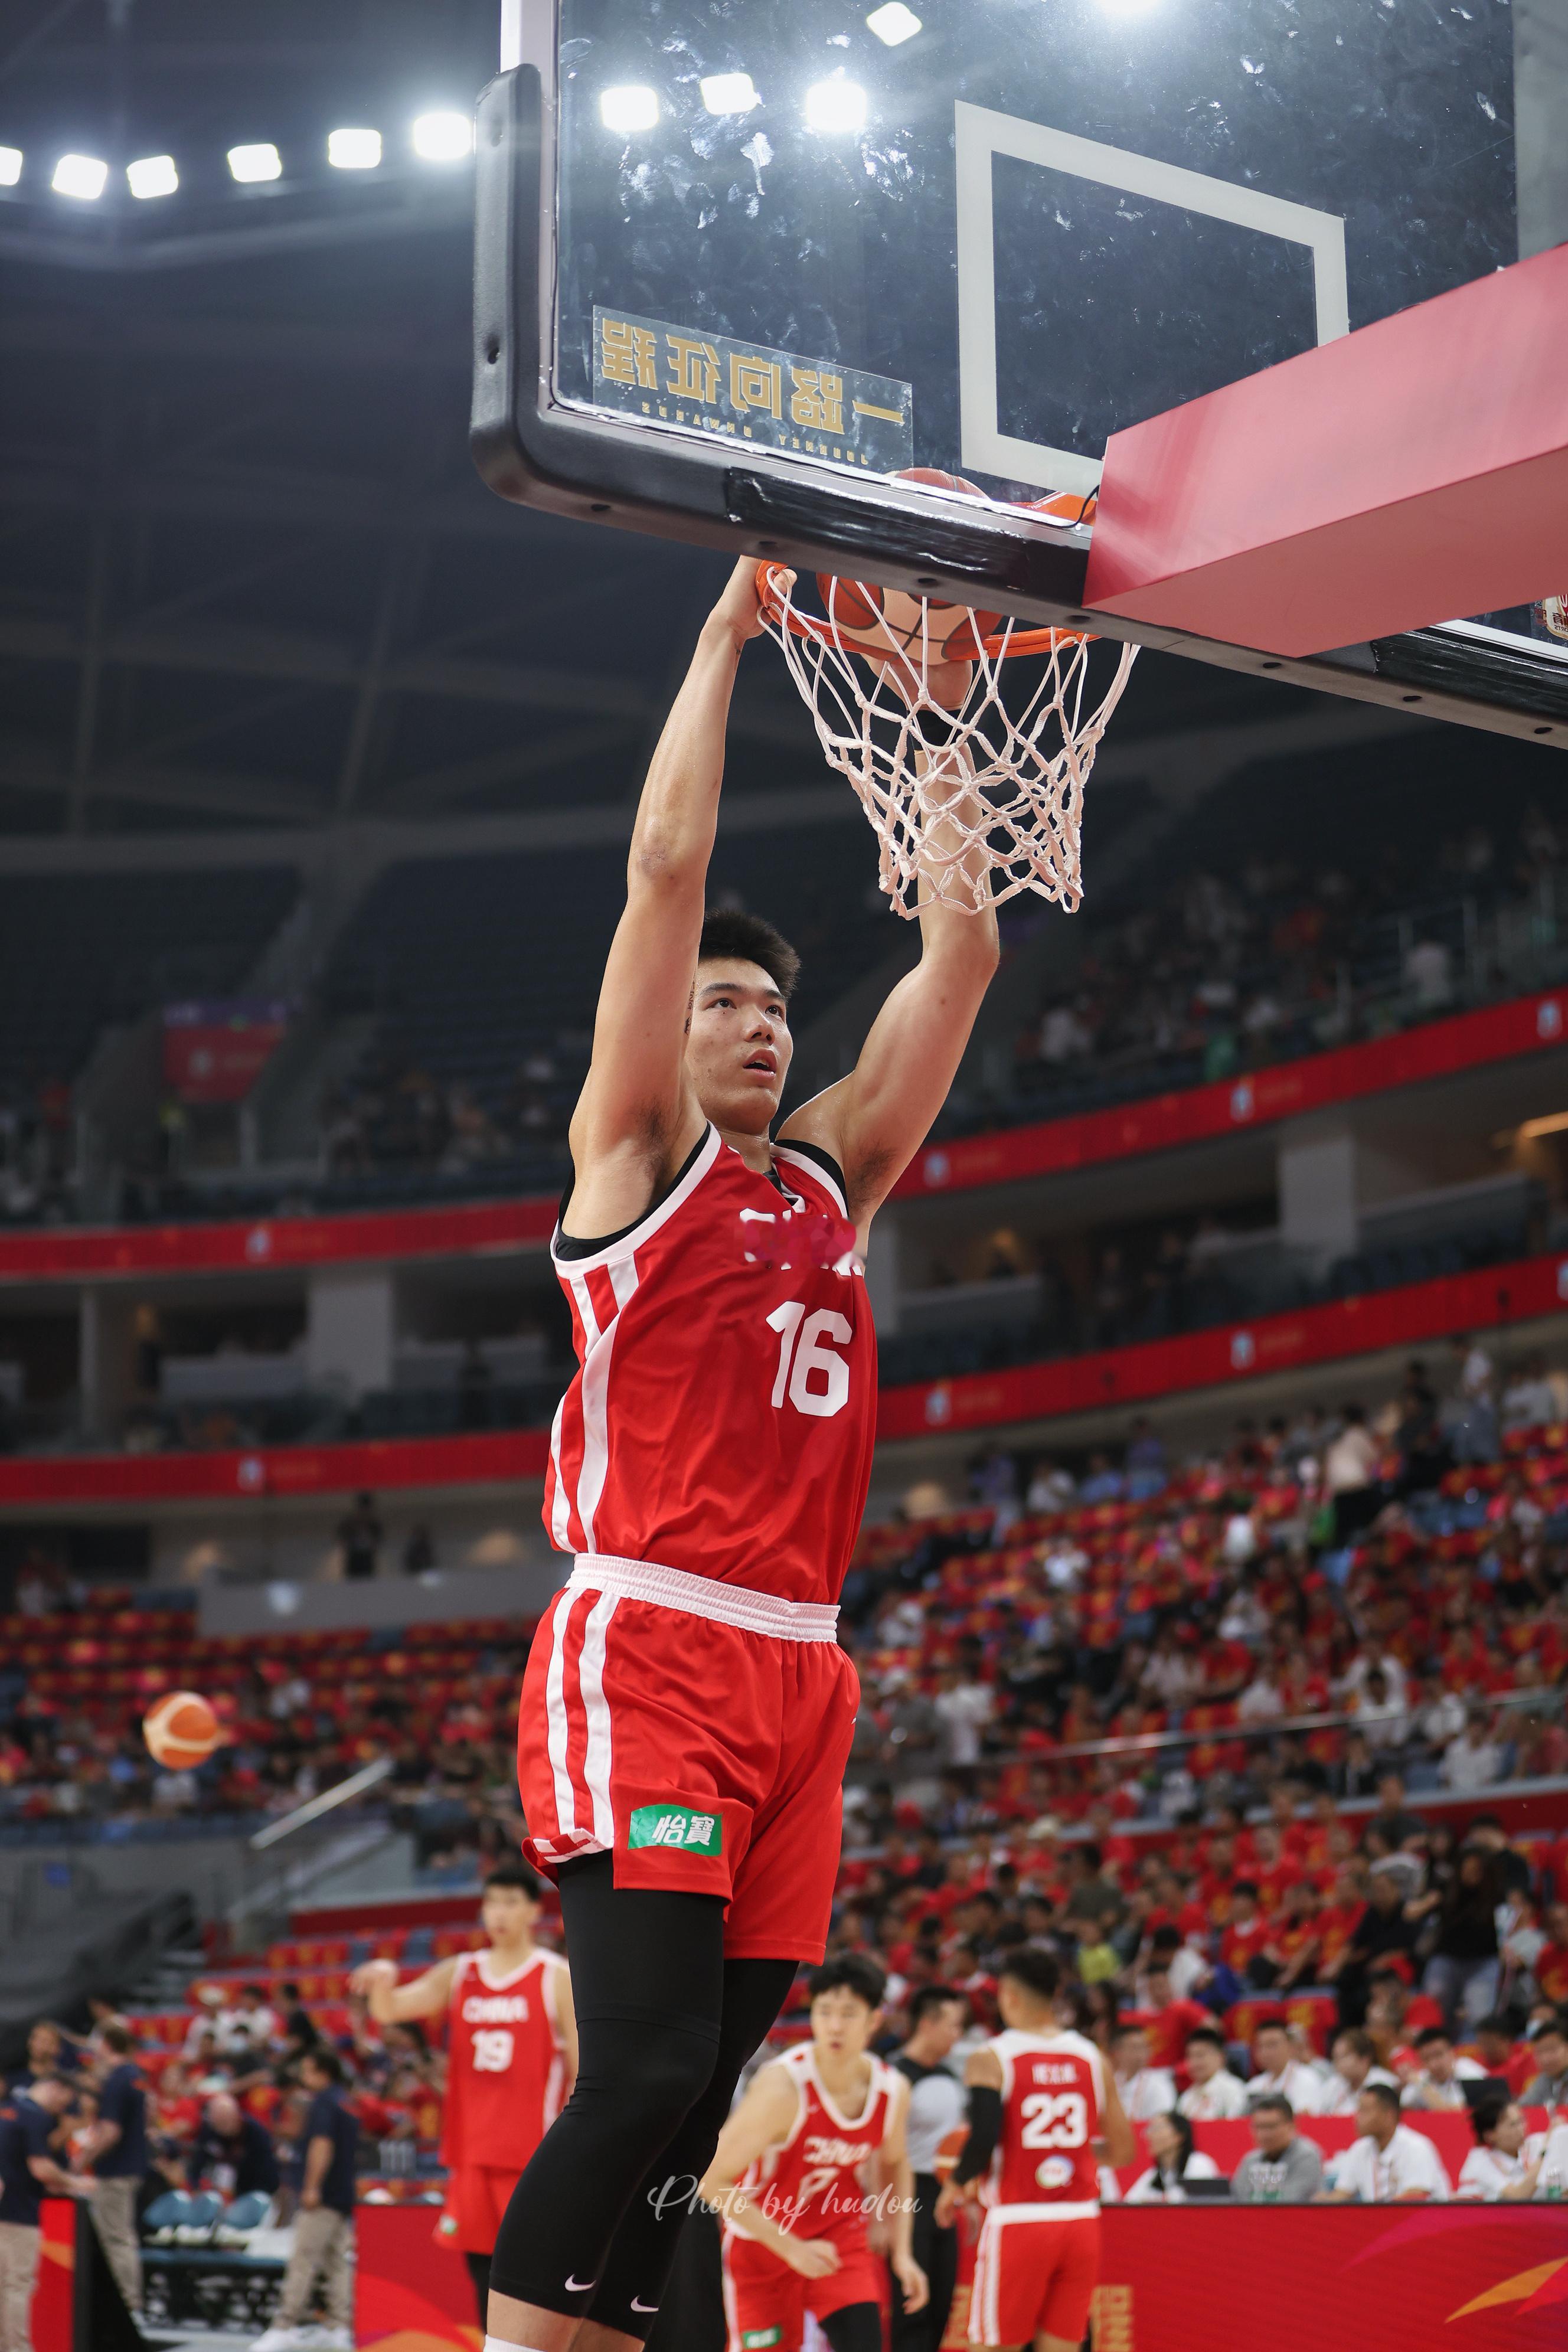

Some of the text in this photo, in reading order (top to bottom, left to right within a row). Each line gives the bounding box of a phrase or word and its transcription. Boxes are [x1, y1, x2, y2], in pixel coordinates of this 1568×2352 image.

[766, 1301, 852, 1417] 16
[651, 1814, 715, 1846] 怡寶
[471, 2028, 514, 2073] 19
[1021, 2093, 1087, 2150] 23
